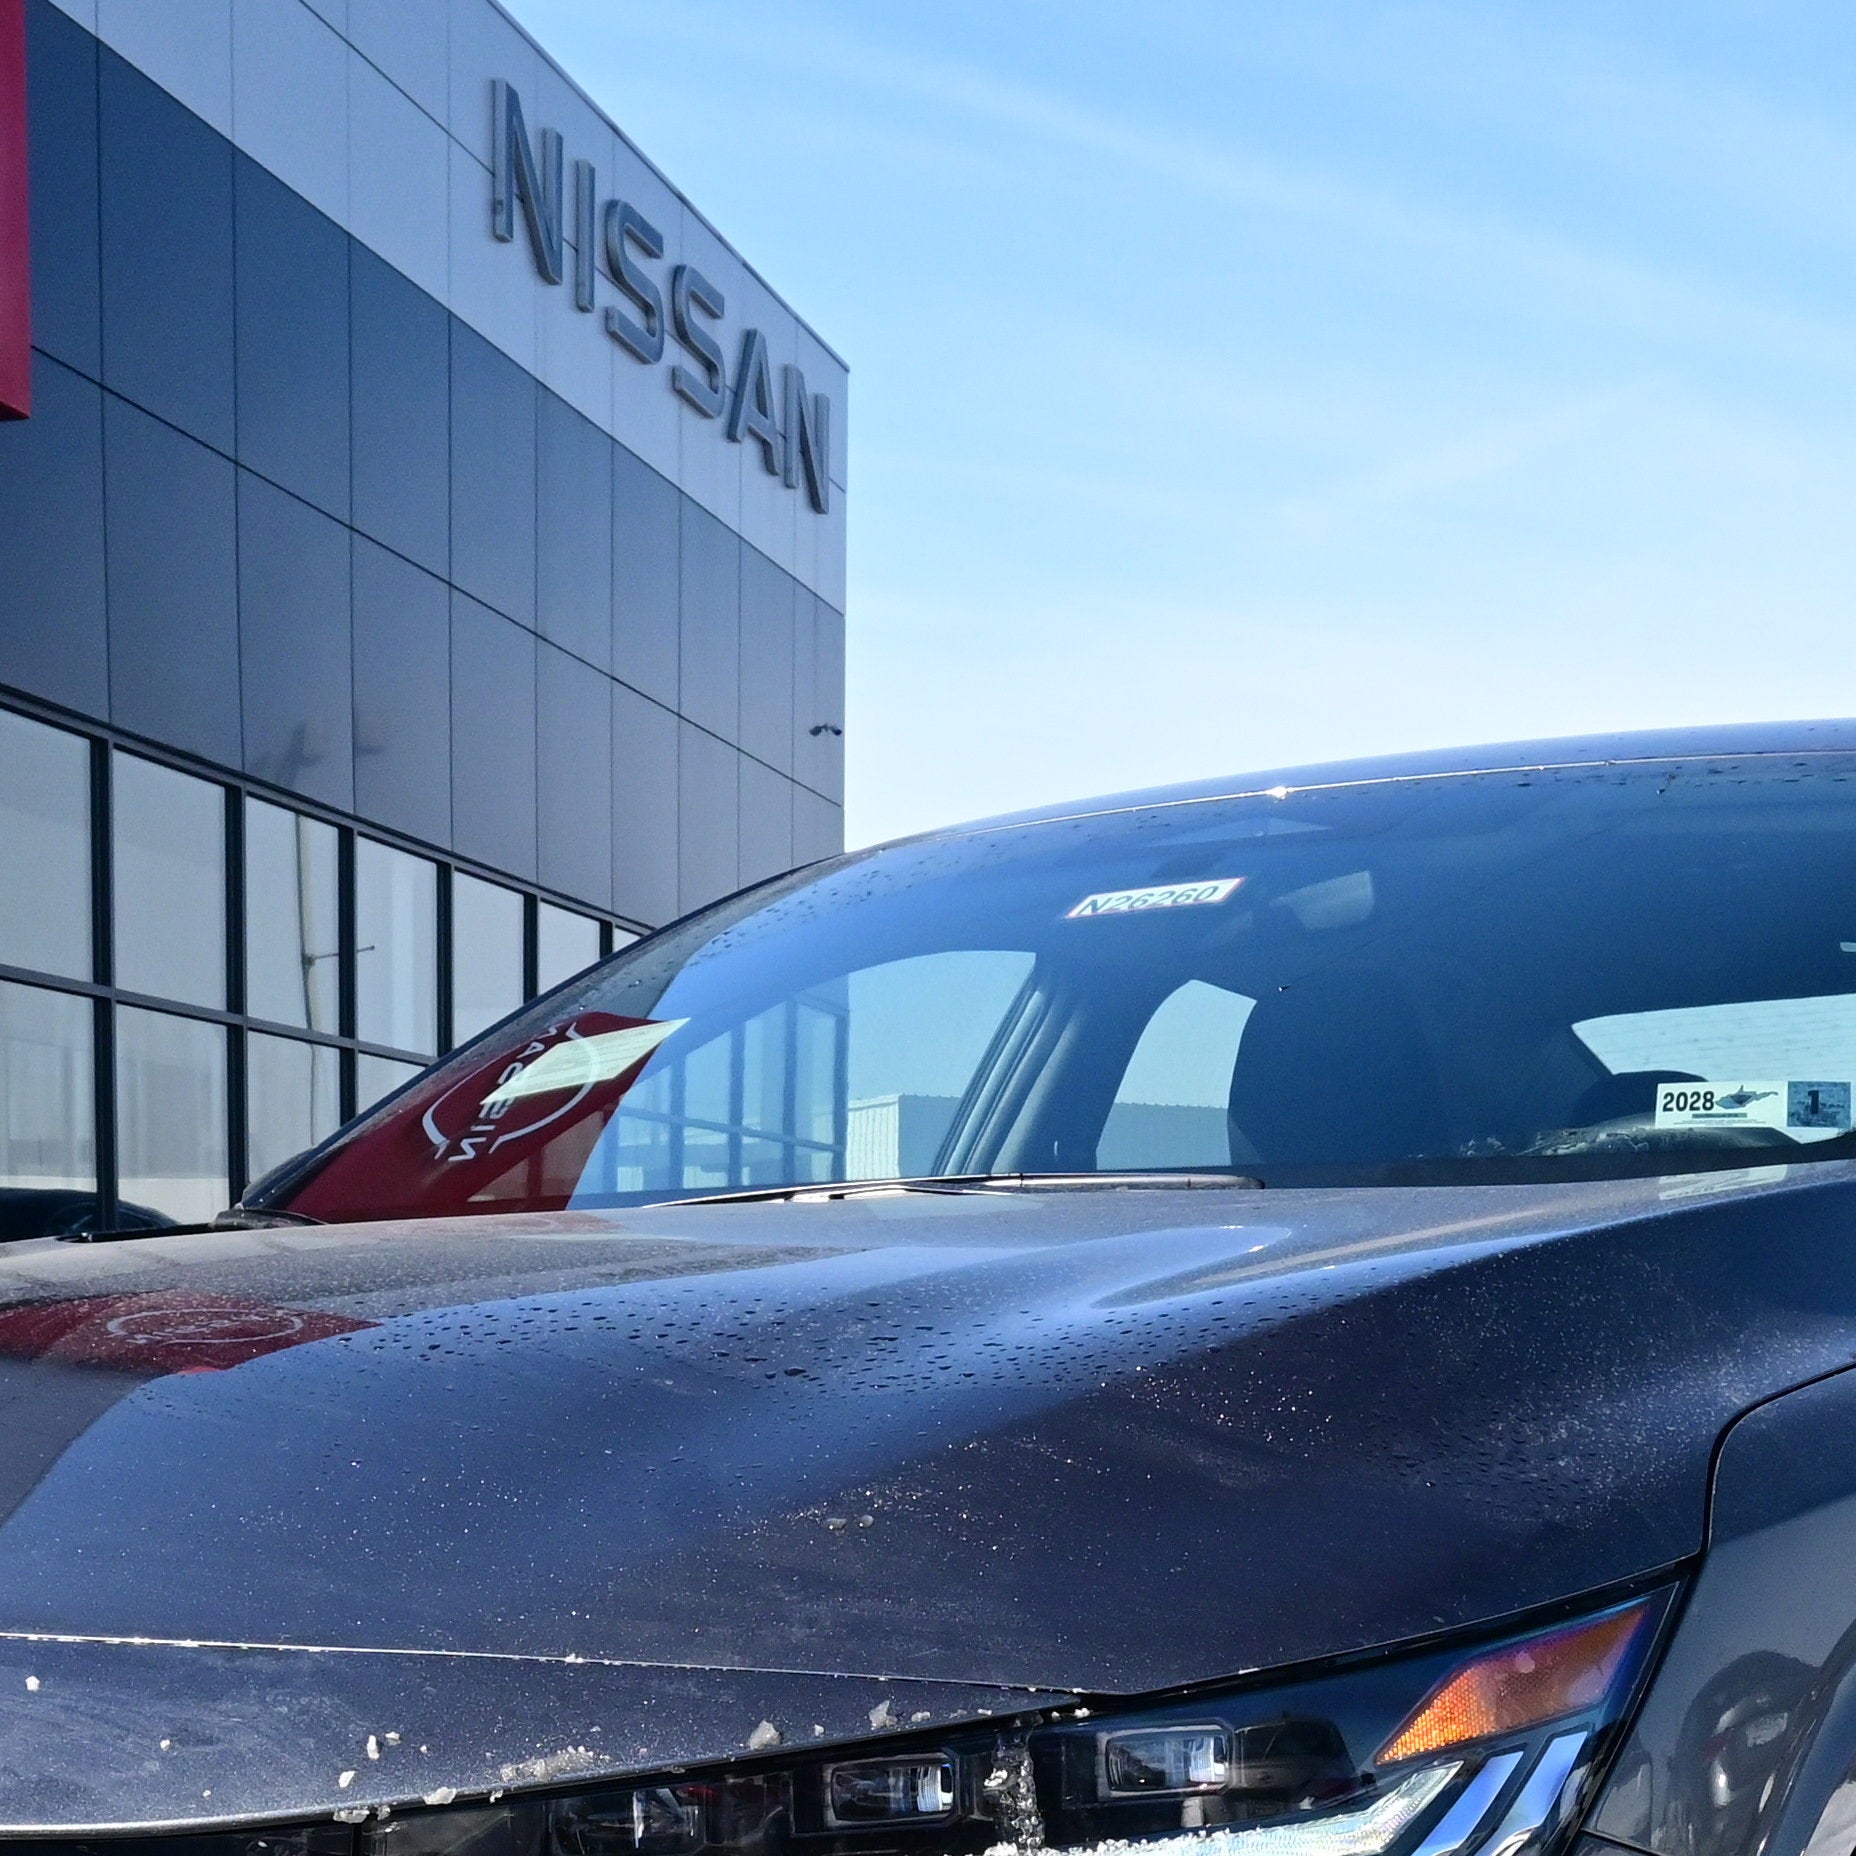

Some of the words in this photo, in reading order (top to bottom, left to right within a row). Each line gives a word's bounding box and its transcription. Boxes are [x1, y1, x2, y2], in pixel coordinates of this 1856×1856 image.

[491, 78, 830, 516] NISSAN
[1083, 884, 1220, 915] N26260
[1662, 1090, 1715, 1113] 2028
[1806, 1089, 1821, 1115] 1
